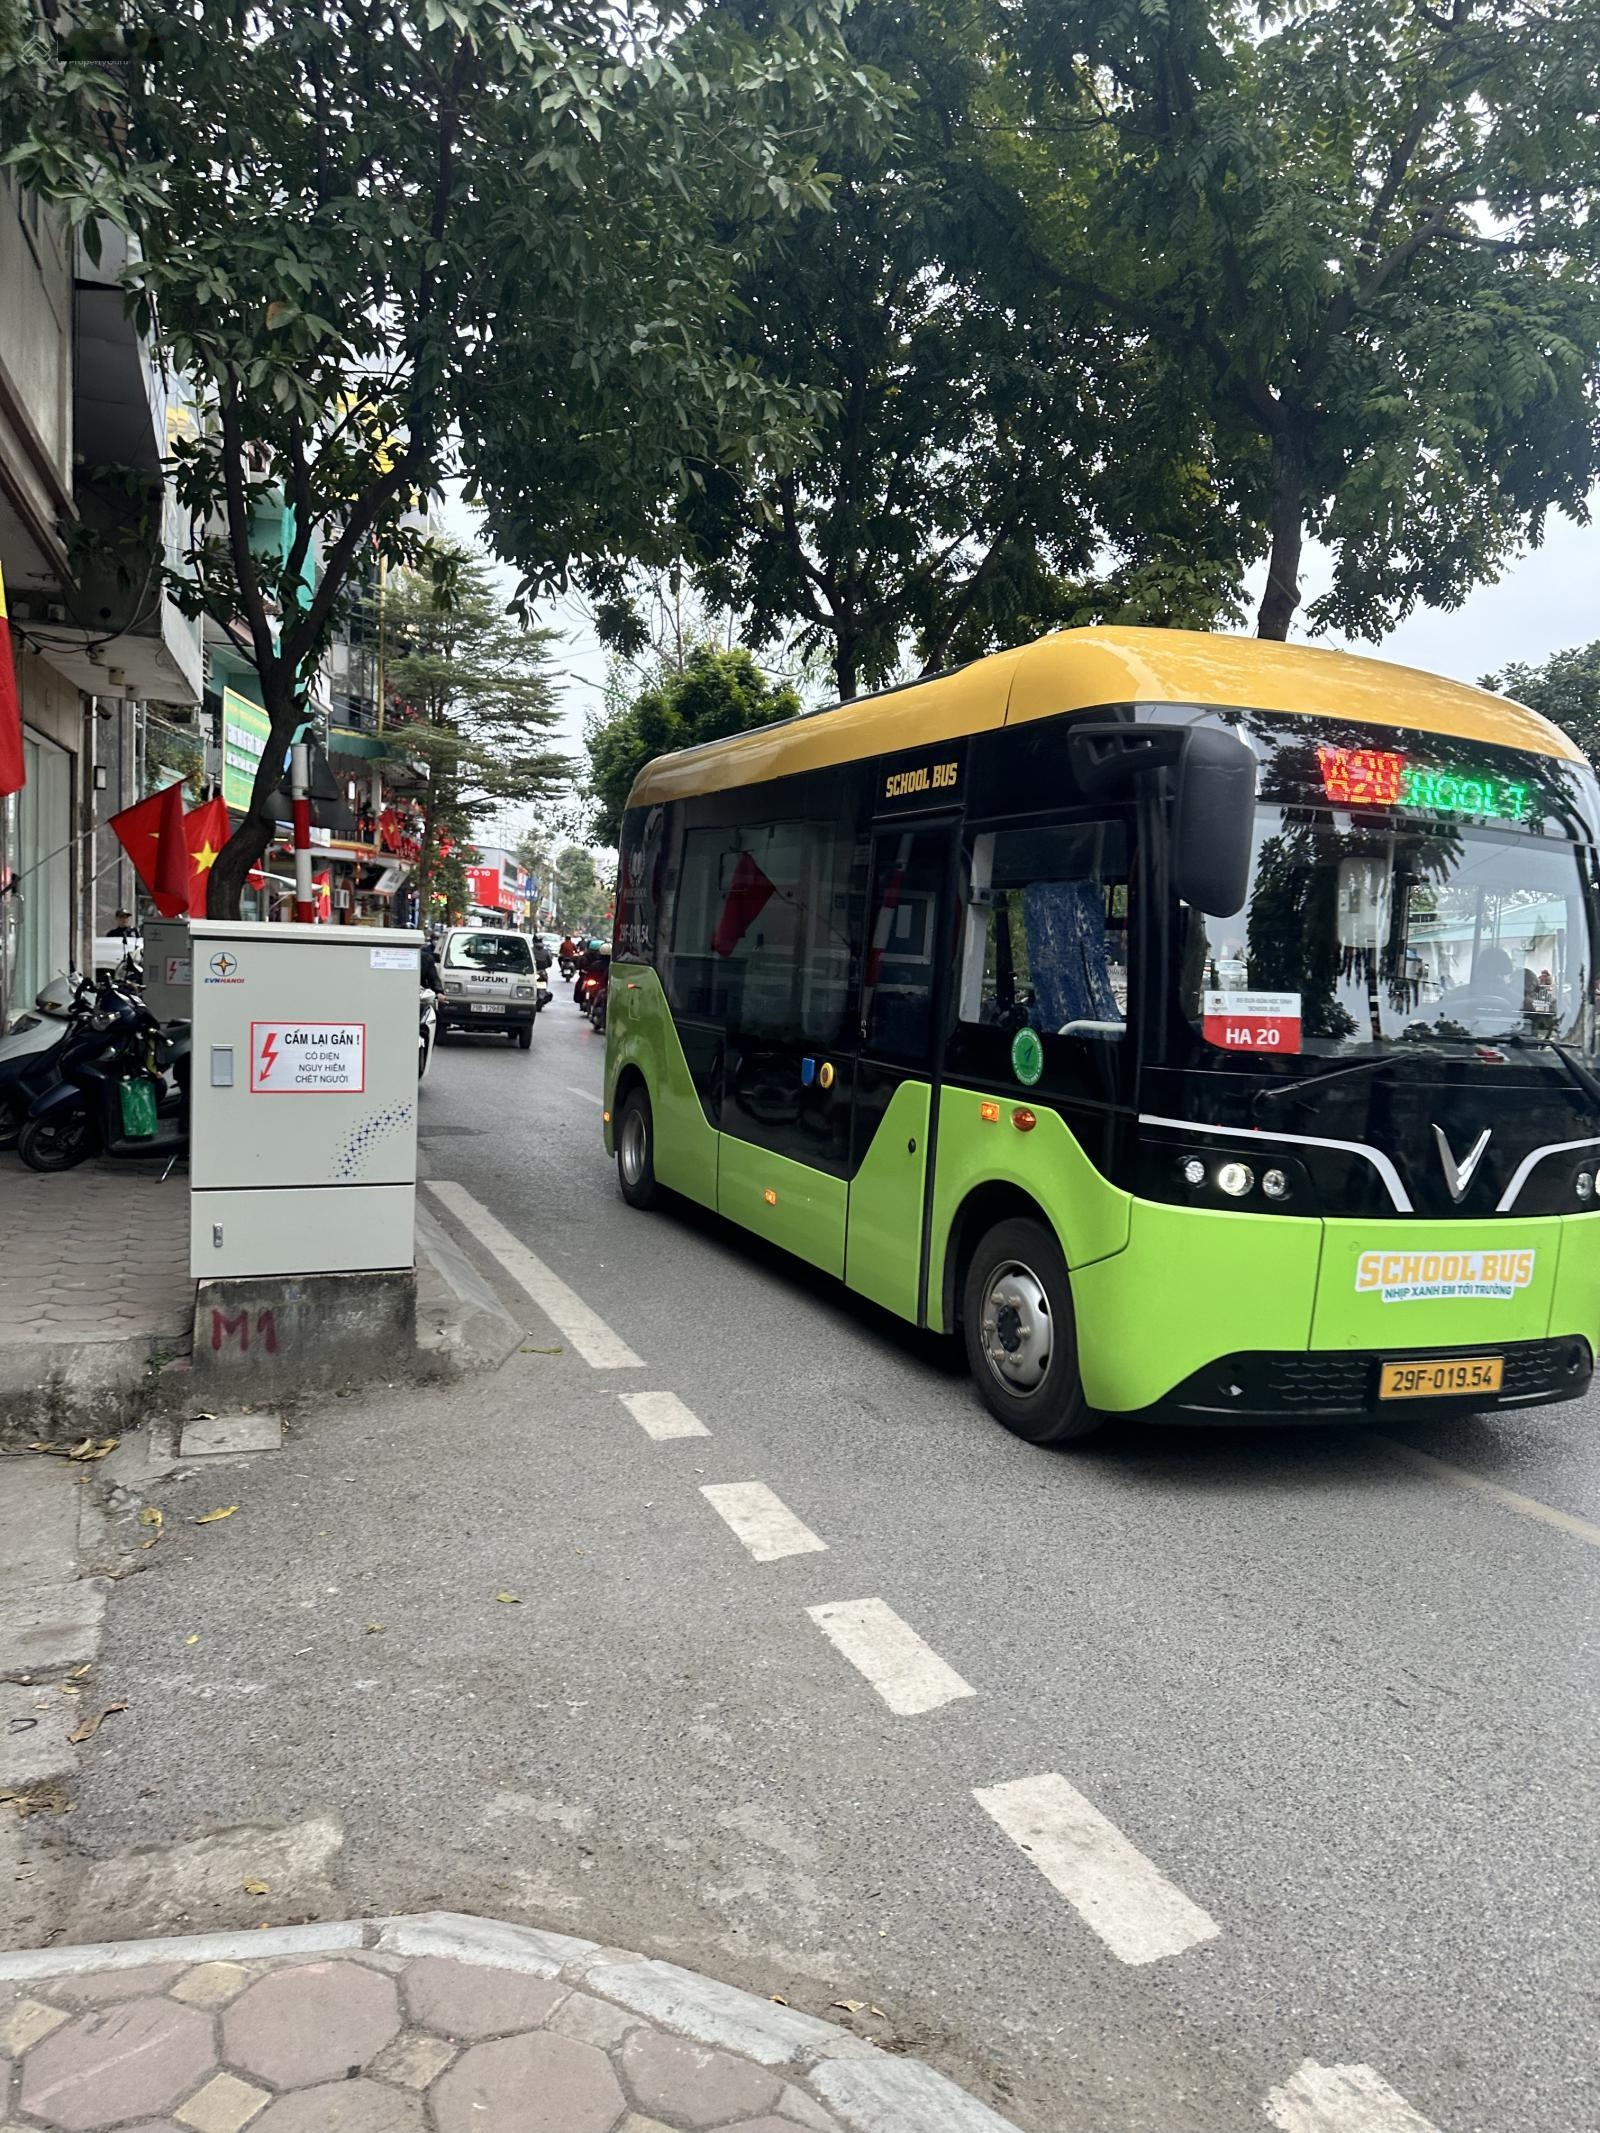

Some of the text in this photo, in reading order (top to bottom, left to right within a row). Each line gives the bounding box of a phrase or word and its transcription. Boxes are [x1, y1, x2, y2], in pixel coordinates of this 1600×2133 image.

[885, 762, 958, 798] SCHOOL BUS
[471, 975, 508, 984] SUZUKI
[284, 1028, 308, 1045] CẤM
[311, 1033, 328, 1048] LẠI
[1225, 1027, 1280, 1046] HA 20
[298, 1064, 323, 1072] NGUY
[1359, 1253, 1532, 1288] SCHOOL BUS
[1384, 1287, 1410, 1300] NHỊP
[1410, 1286, 1440, 1297] XANH
[1441, 1285, 1457, 1295] EM
[1391, 1365, 1493, 1392] 29F-019.54
